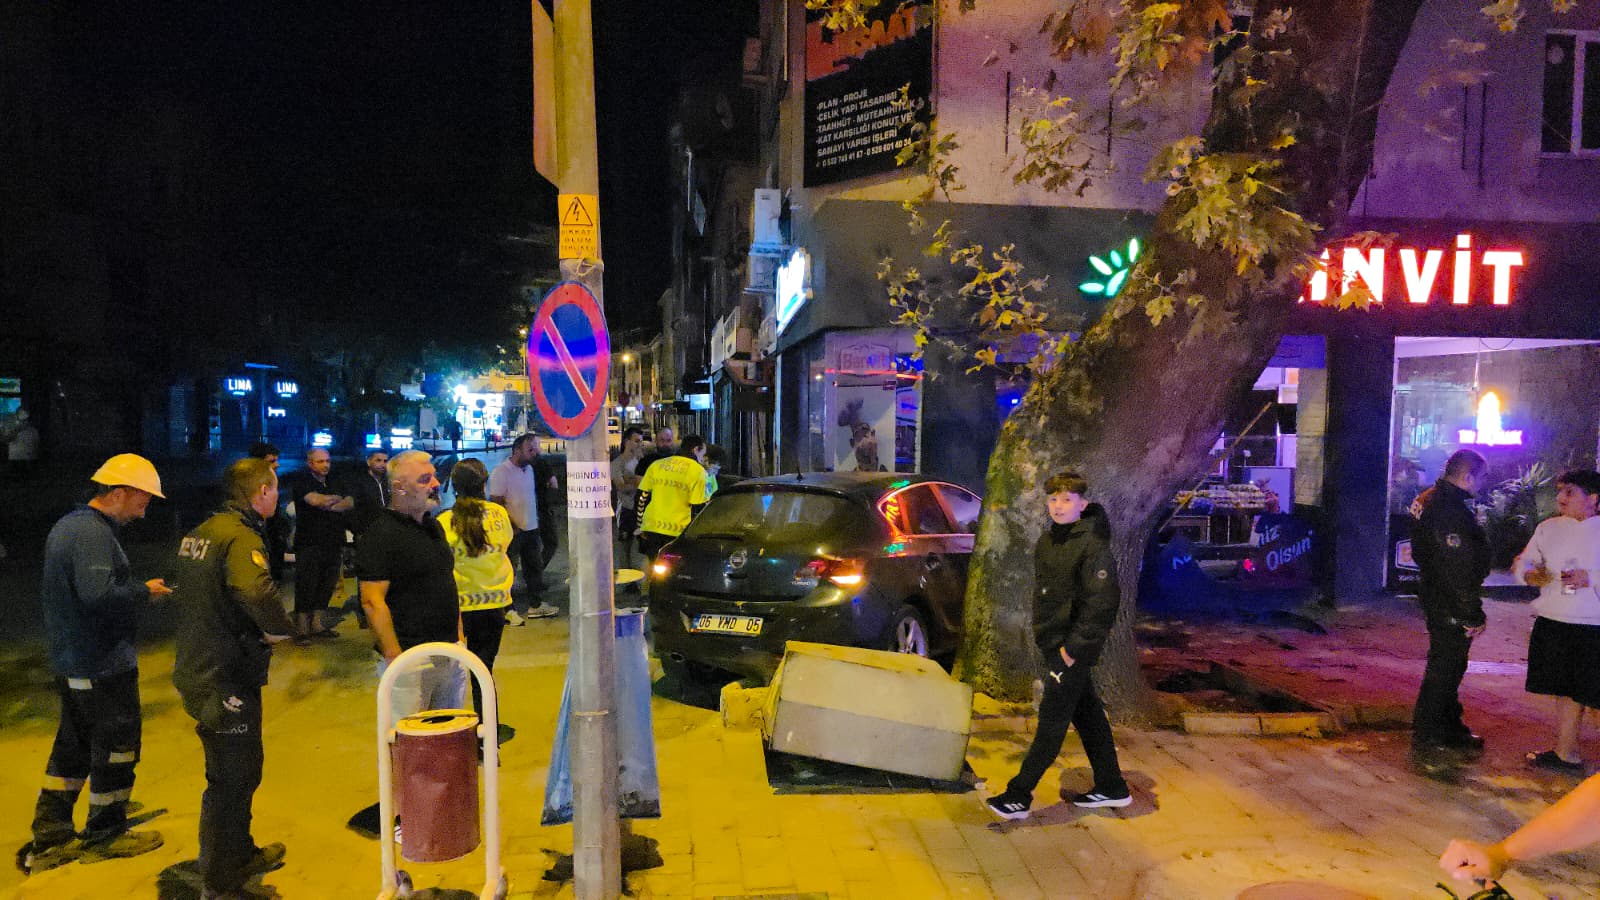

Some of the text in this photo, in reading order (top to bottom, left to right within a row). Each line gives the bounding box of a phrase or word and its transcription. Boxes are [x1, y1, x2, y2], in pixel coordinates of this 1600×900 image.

[843, 88, 868, 102] PROJE
[872, 116, 899, 130] KONUT
[900, 112, 913, 123] VE
[699, 615, 713, 628] 06
[746, 618, 761, 632] 05
